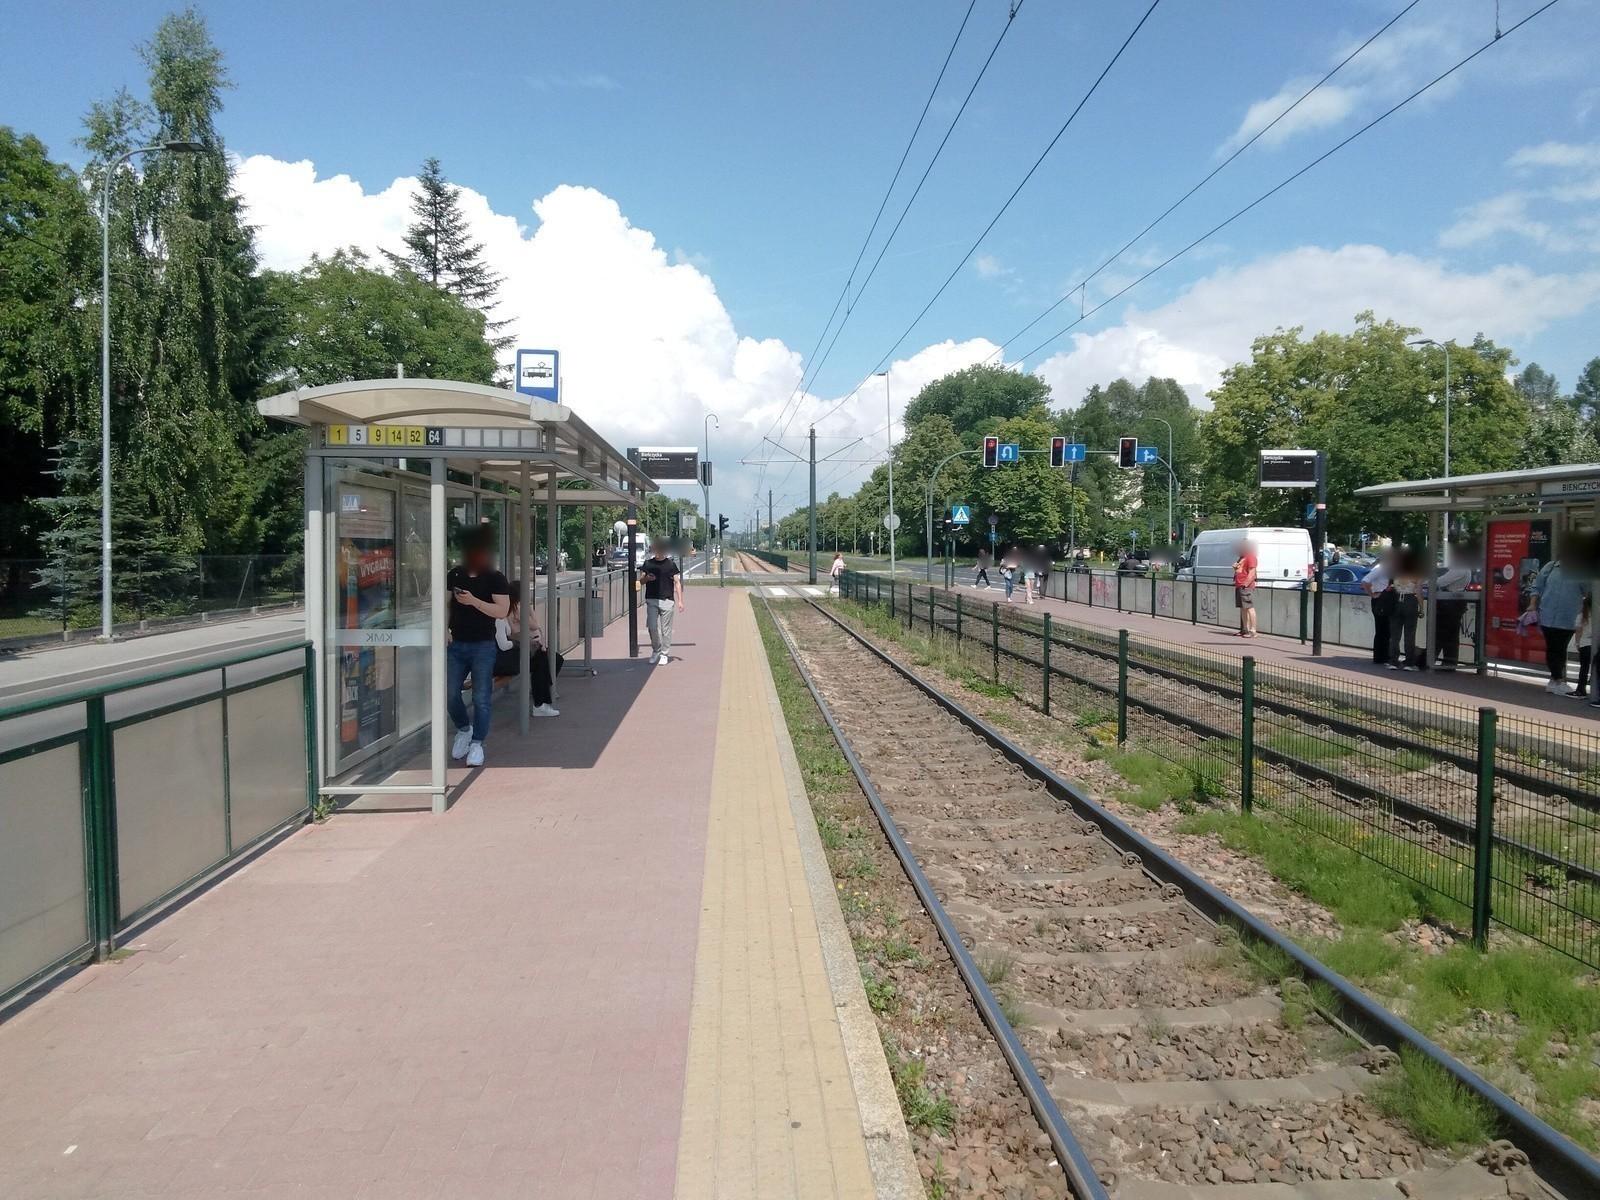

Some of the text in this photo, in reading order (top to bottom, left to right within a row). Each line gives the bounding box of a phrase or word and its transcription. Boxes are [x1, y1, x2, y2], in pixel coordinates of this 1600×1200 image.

[336, 429, 441, 443] 1 5 9 14 52 64
